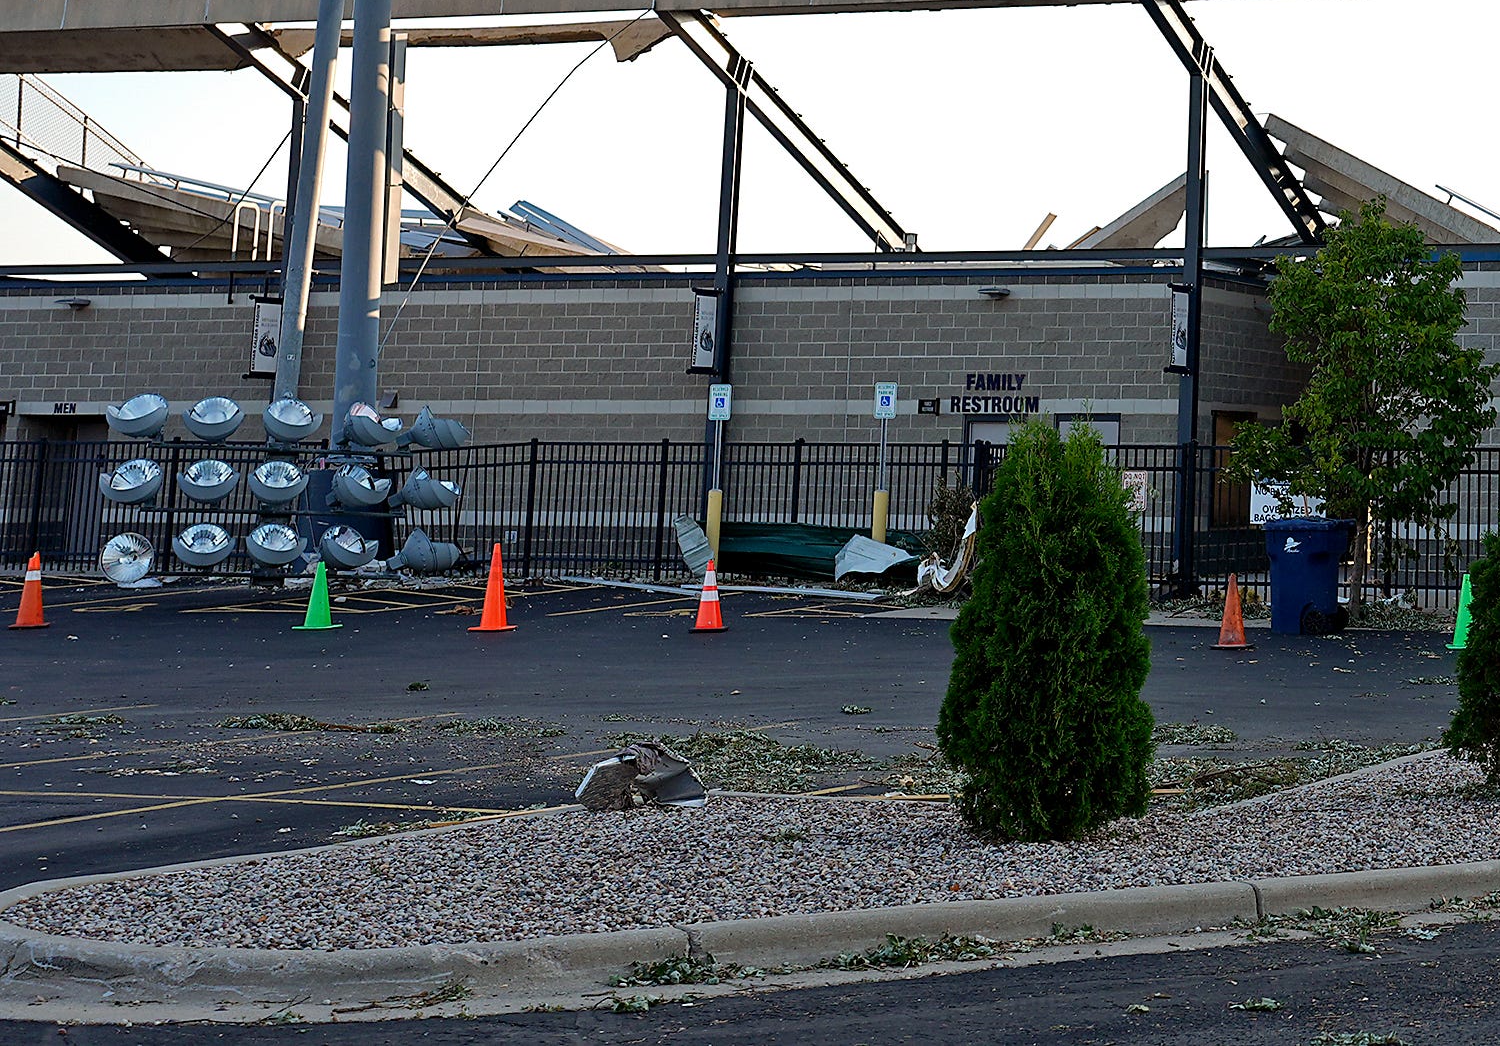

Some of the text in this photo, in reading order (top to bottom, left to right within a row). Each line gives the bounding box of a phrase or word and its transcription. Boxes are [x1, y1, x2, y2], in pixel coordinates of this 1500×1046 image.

[966, 374, 1026, 391] FAMILY
[54, 403, 76, 413] MEN
[950, 395, 1039, 413] RESTROOM
[1262, 505, 1312, 514] OVEIZED
